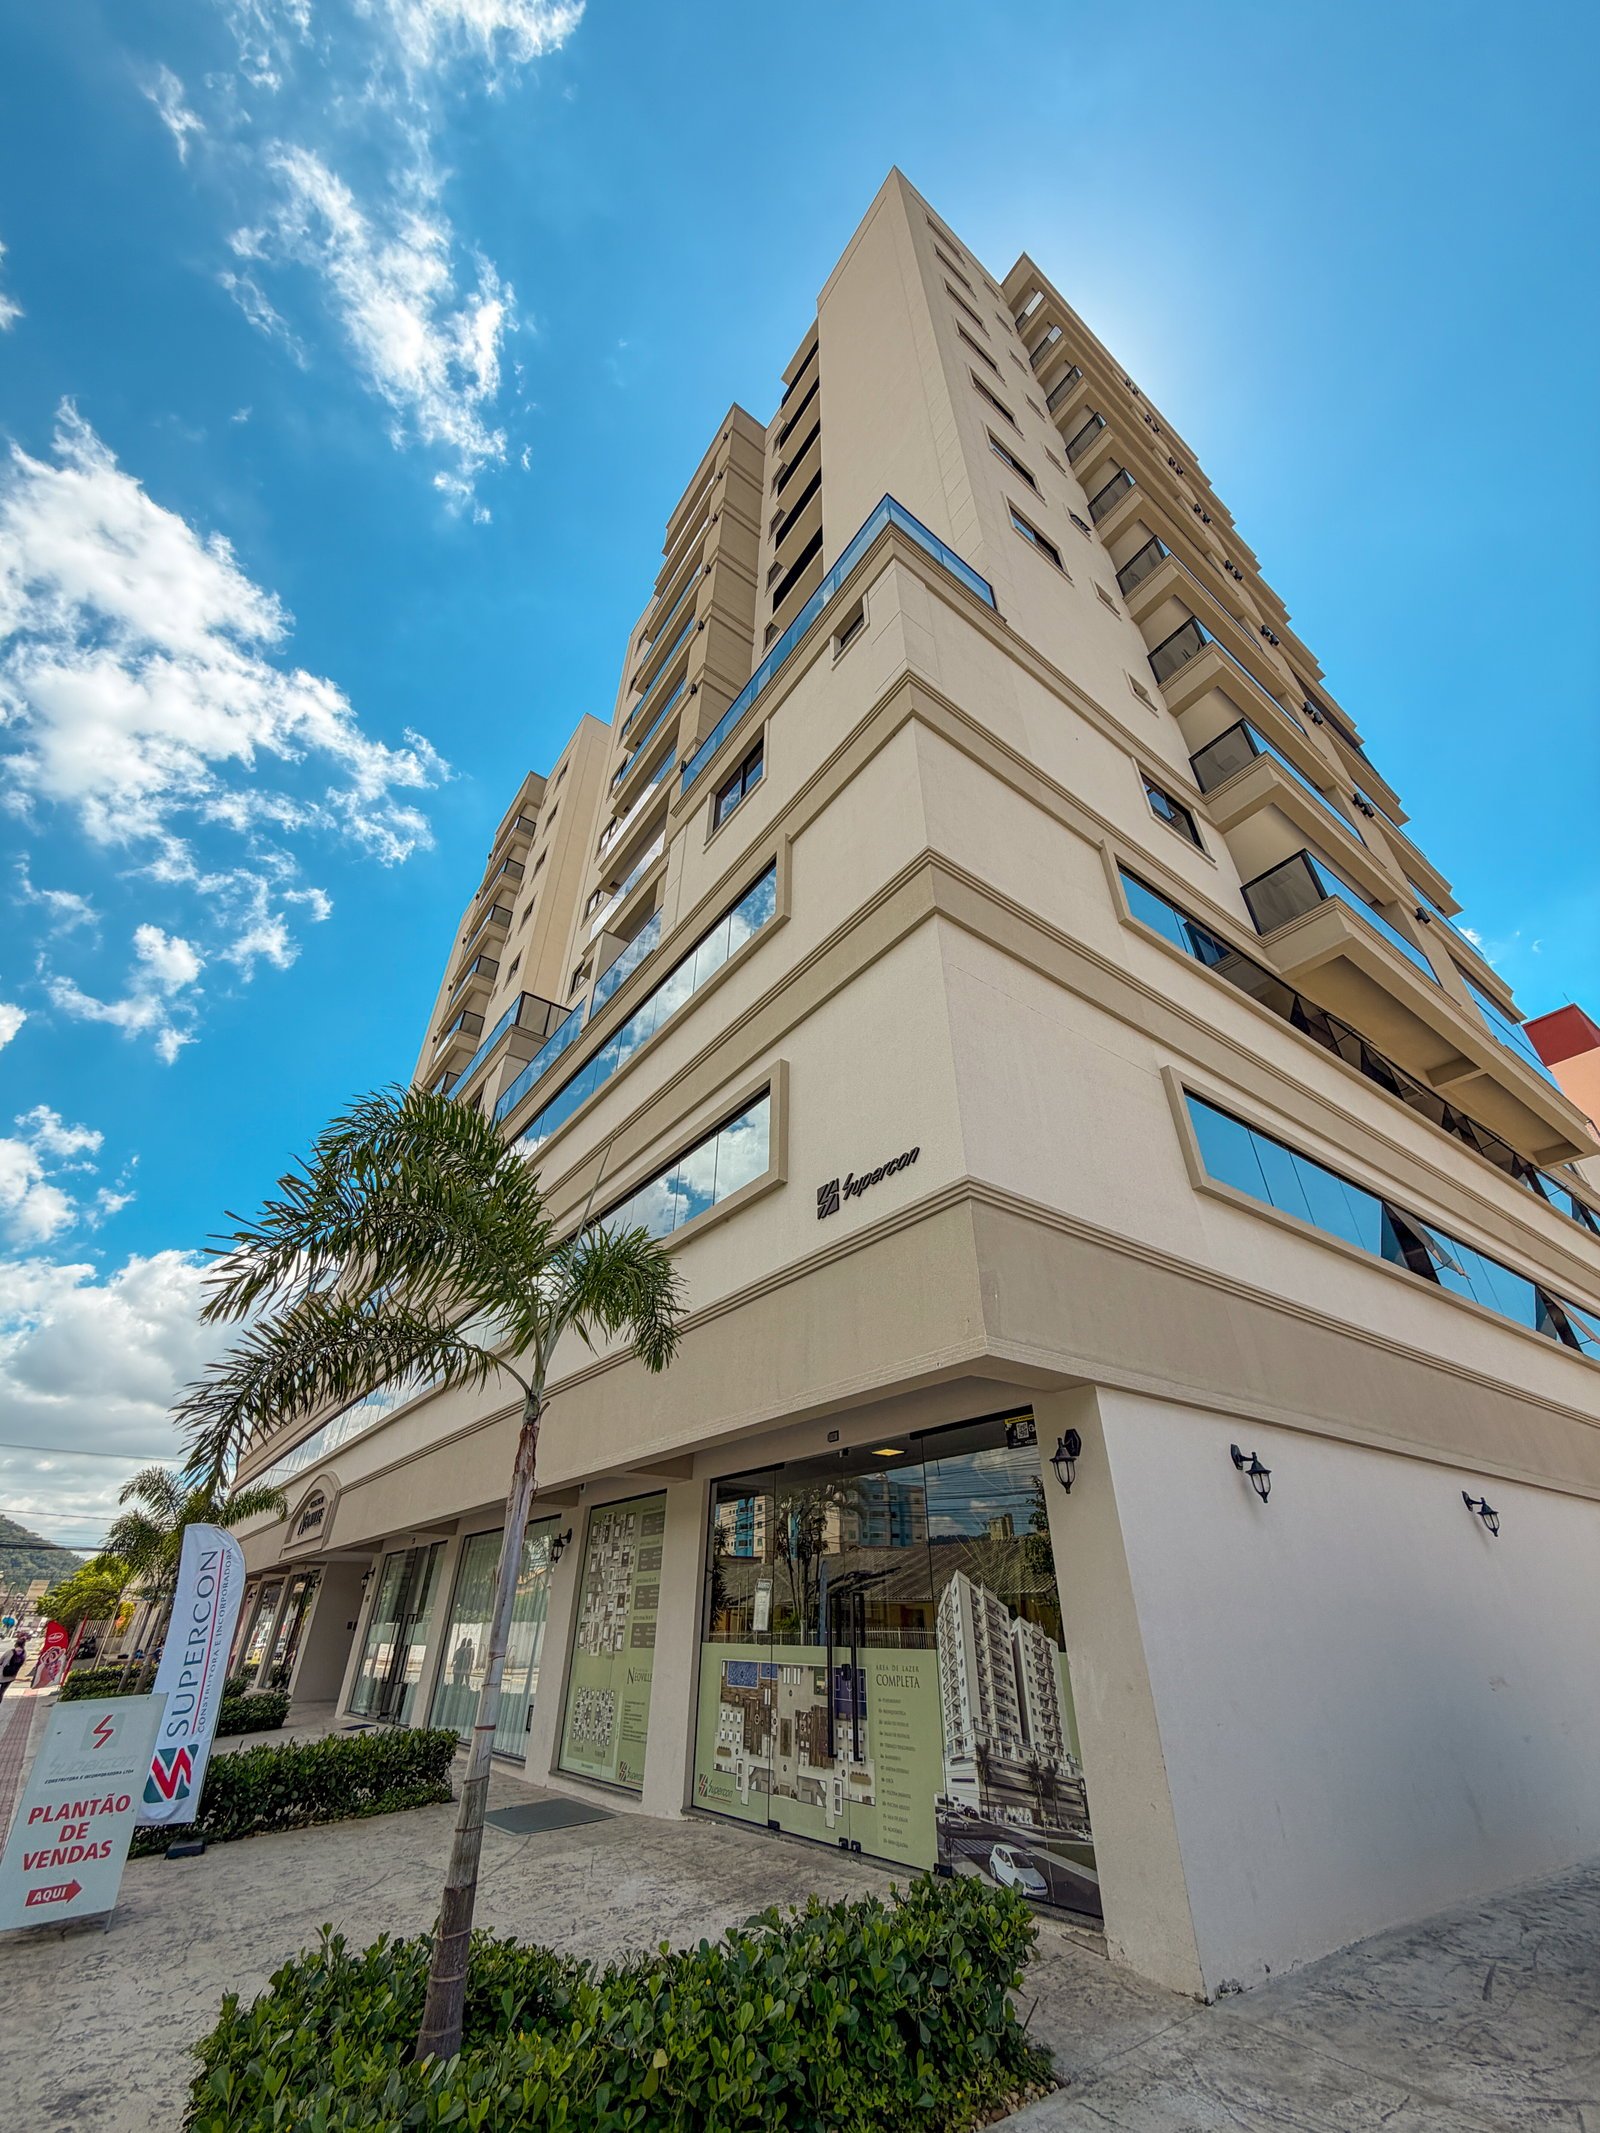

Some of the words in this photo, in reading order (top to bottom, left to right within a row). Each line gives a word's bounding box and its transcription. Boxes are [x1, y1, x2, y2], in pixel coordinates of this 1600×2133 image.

[842, 1146, 920, 1200] Supercon
[166, 1550, 219, 1738] SUPERCON
[197, 1649, 220, 1733] CONSTRUTORA
[215, 1547, 233, 1638] INCORPORADORA
[876, 1673, 921, 1689] COMPLETA
[27, 1793, 132, 1825] PLANTÃO
[58, 1821, 91, 1843] DE
[22, 1840, 113, 1871] VENDAS
[32, 1887, 68, 1903] AQUI
